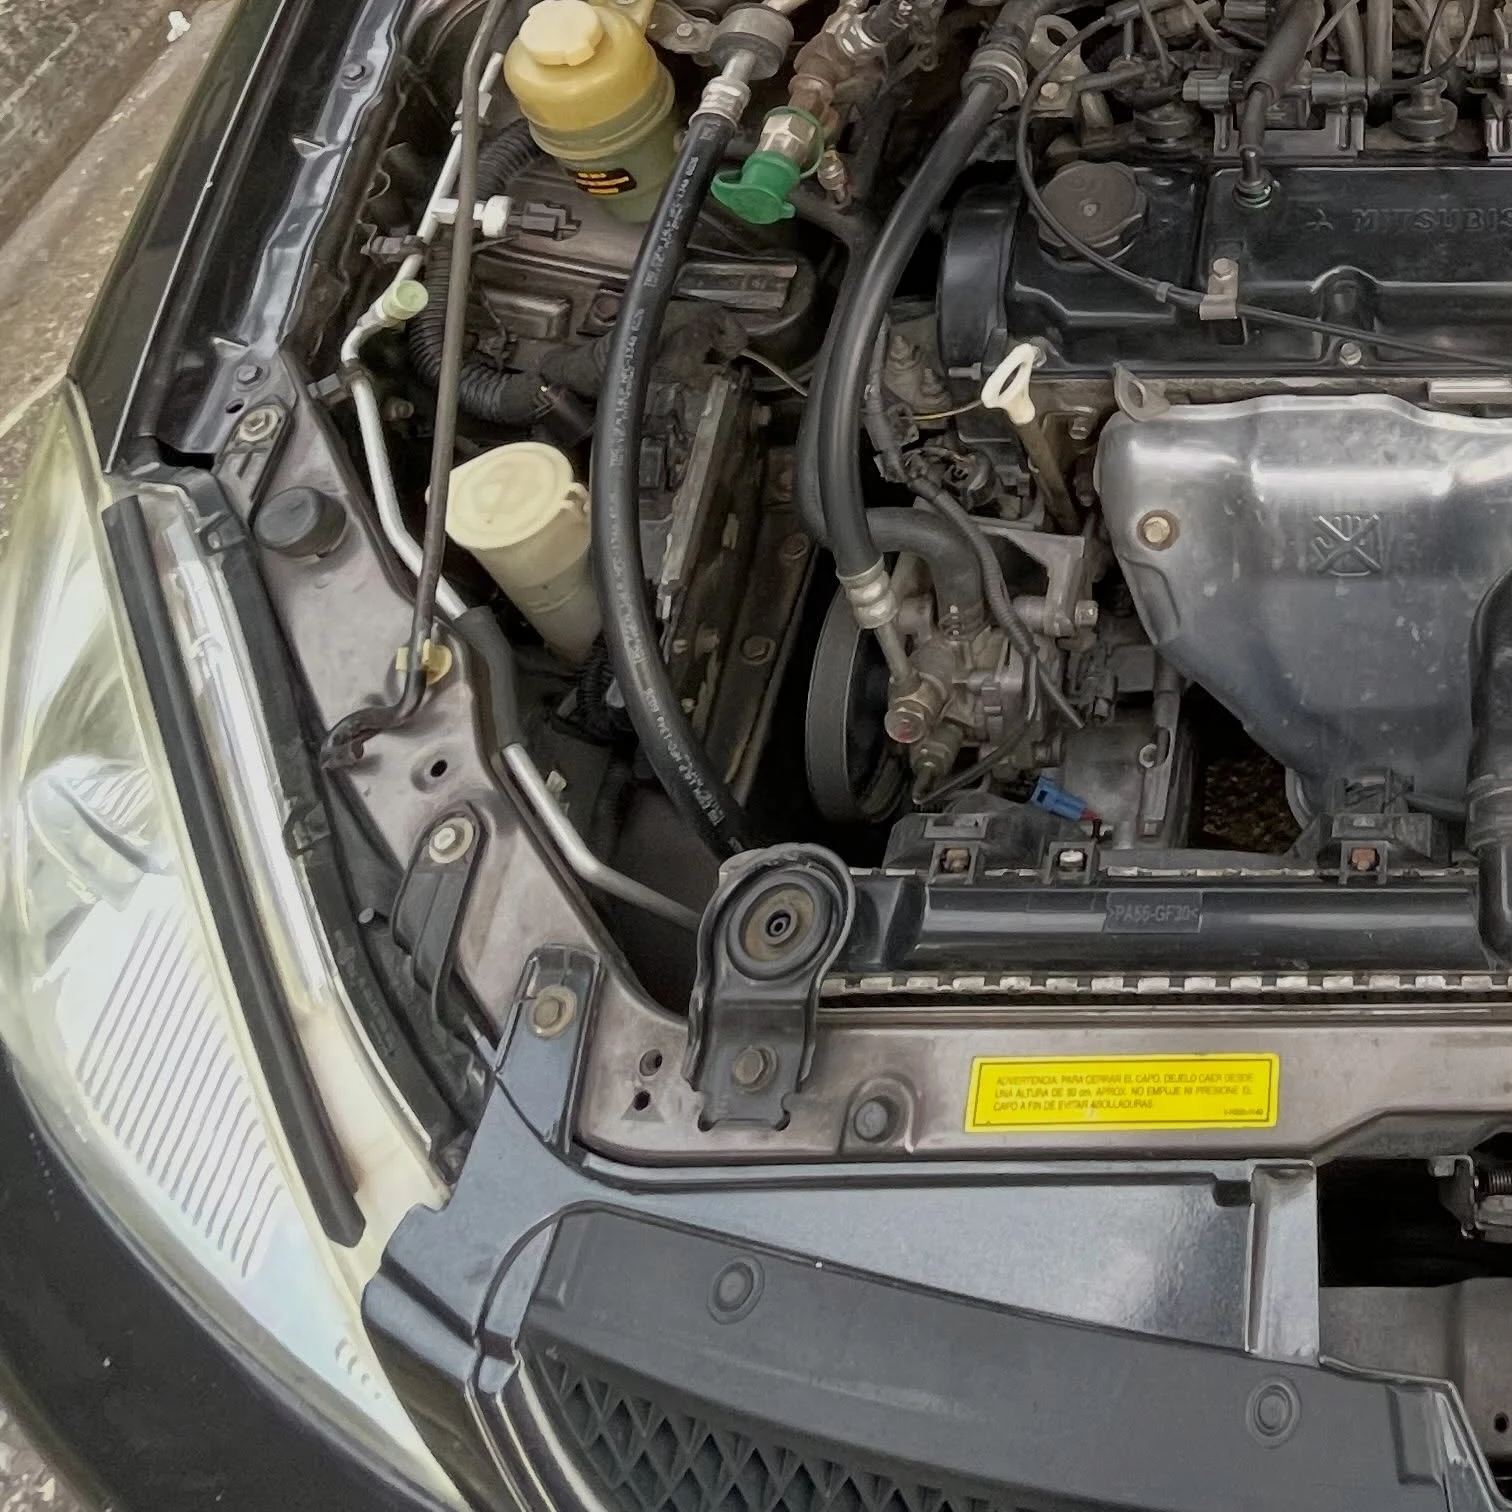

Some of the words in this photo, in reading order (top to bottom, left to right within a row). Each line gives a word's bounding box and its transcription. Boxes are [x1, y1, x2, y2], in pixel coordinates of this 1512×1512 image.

[1016, 1087, 1049, 1098] ALTURA
[1052, 1087, 1064, 1097] DE
[1131, 1086, 1145, 1096] NO
